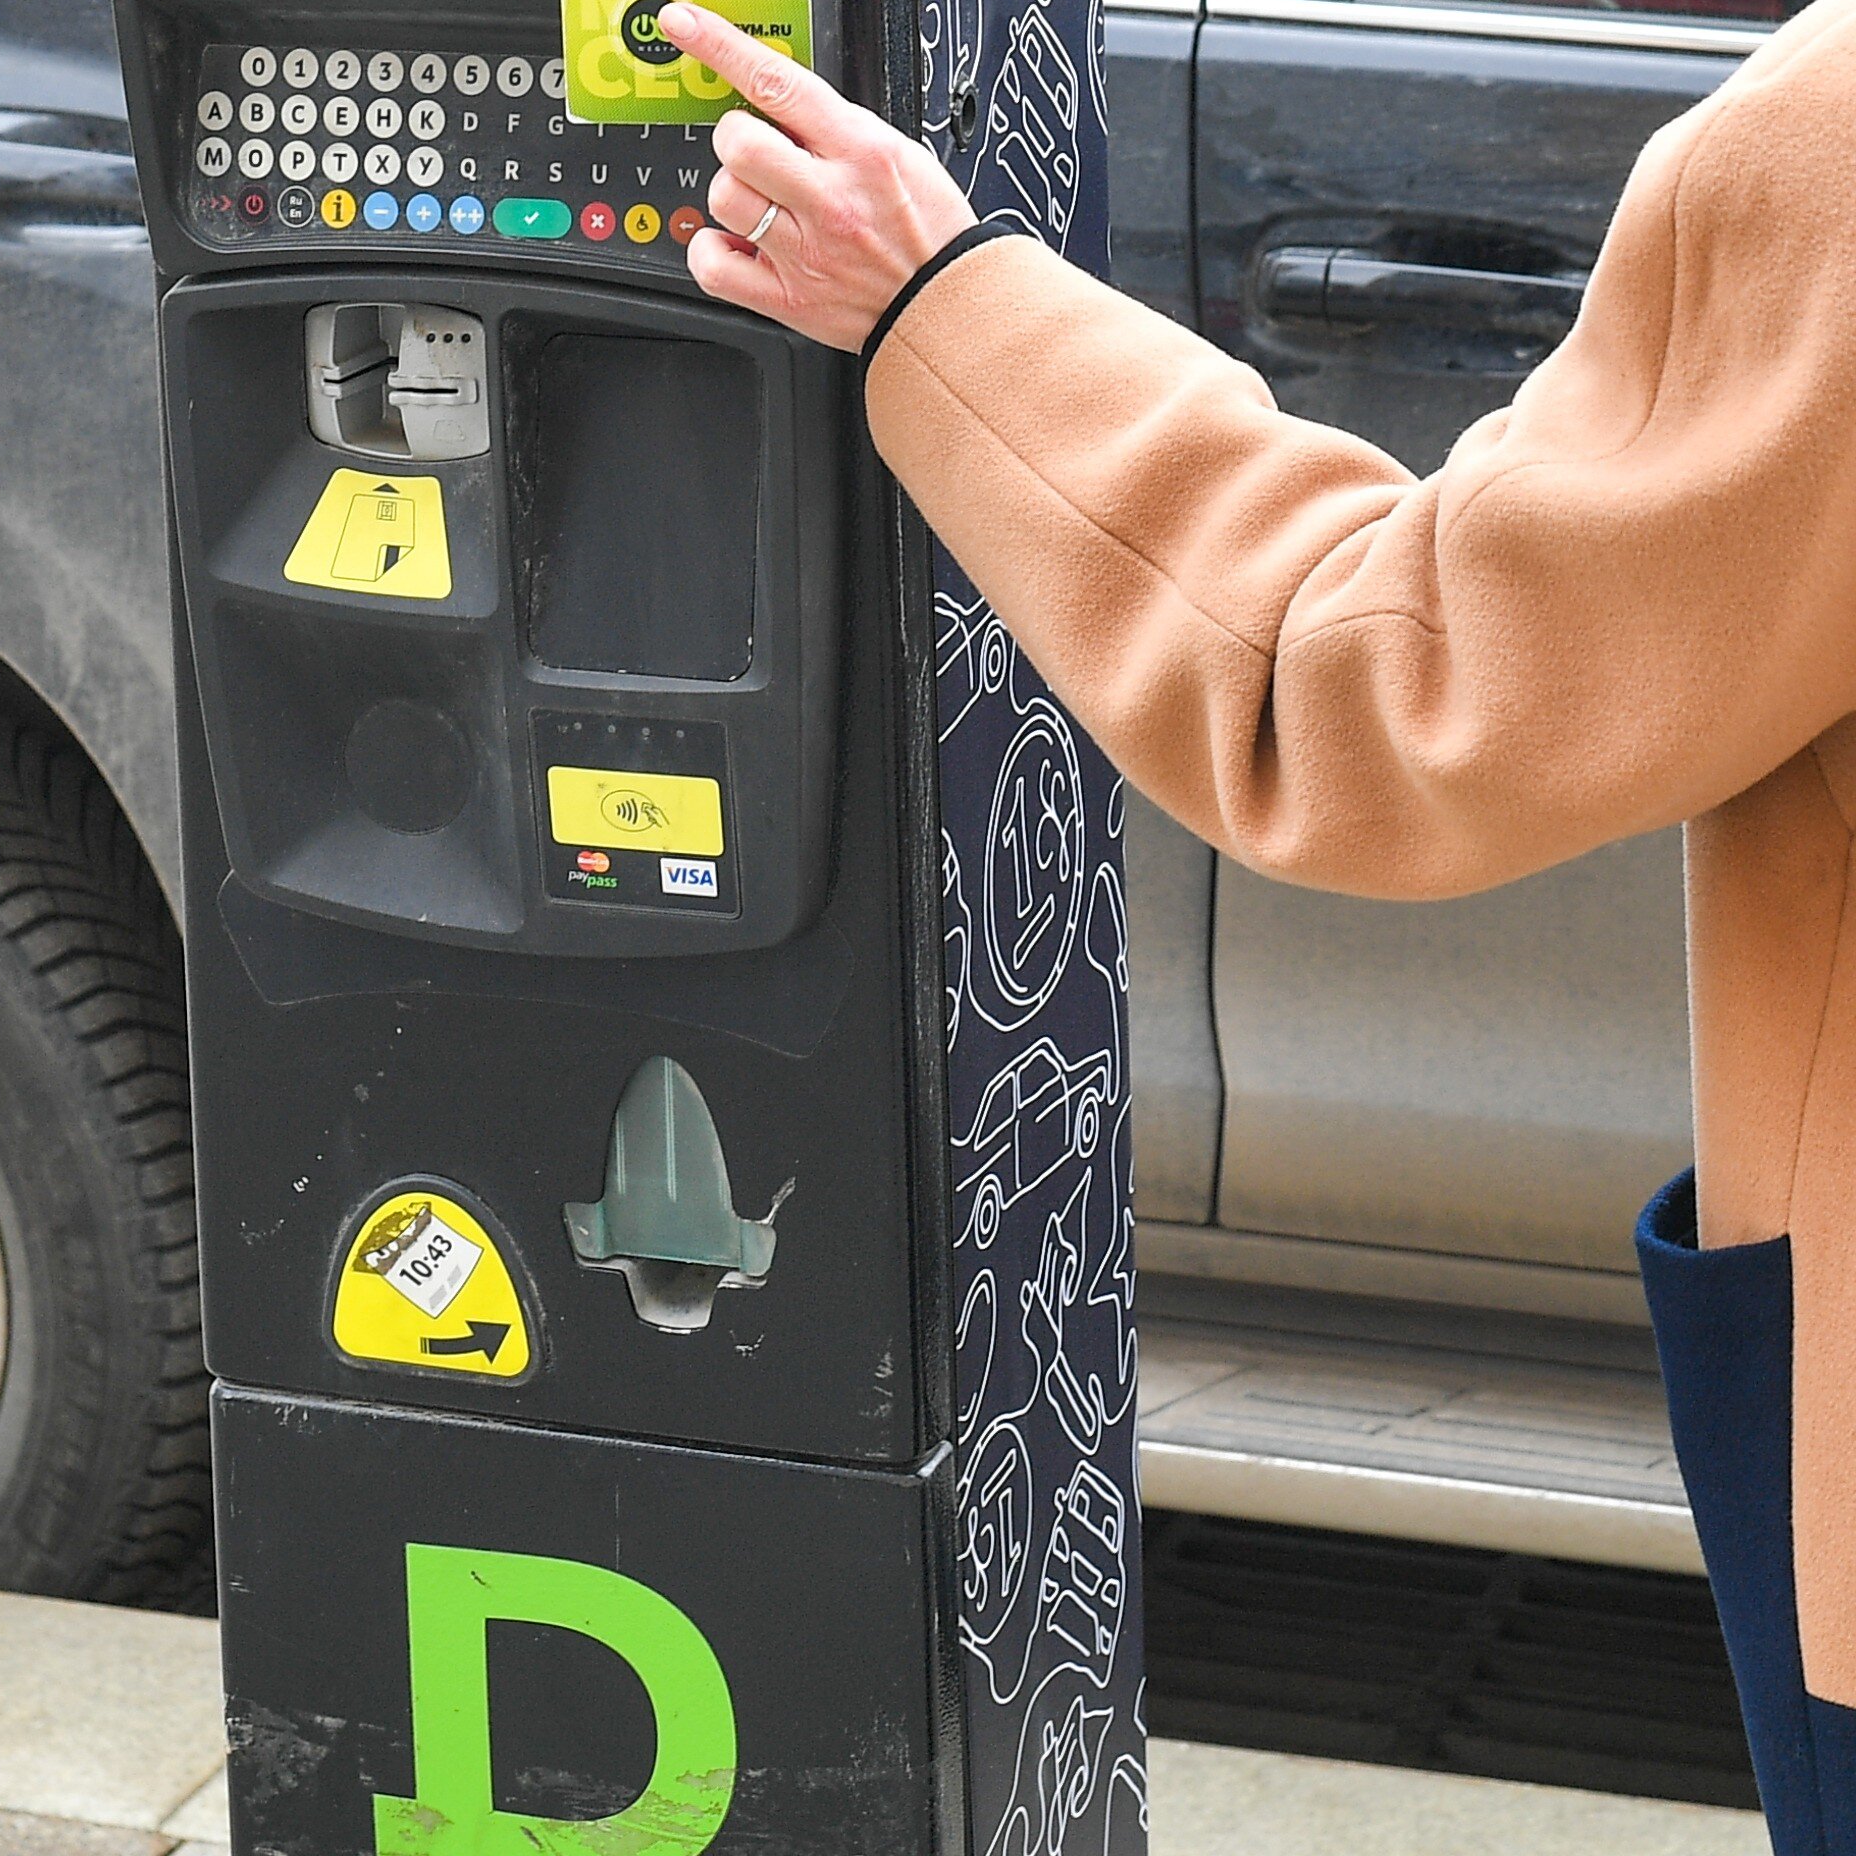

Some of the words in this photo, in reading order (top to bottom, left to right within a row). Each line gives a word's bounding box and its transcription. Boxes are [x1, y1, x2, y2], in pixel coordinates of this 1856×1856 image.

[252, 57, 265, 76] 0
[295, 60, 306, 77] 1
[337, 60, 349, 79] 2
[379, 62, 392, 81] 3
[421, 64, 435, 82] 4
[466, 66, 478, 84] 5
[508, 68, 521, 86] 6
[553, 70, 564, 88] 7
[463, 112, 479, 131] D
[507, 114, 521, 133] F
[548, 115, 564, 135] G
[460, 158, 476, 181] Q
[504, 160, 519, 180] R
[549, 163, 562, 182] S
[593, 164, 608, 184] U
[637, 167, 652, 185] V
[678, 169, 699, 188] W
[290, 196, 302, 206] Ru
[290, 208, 302, 218] En
[667, 868, 713, 886] VISA
[400, 1235, 452, 1286] 10:43
